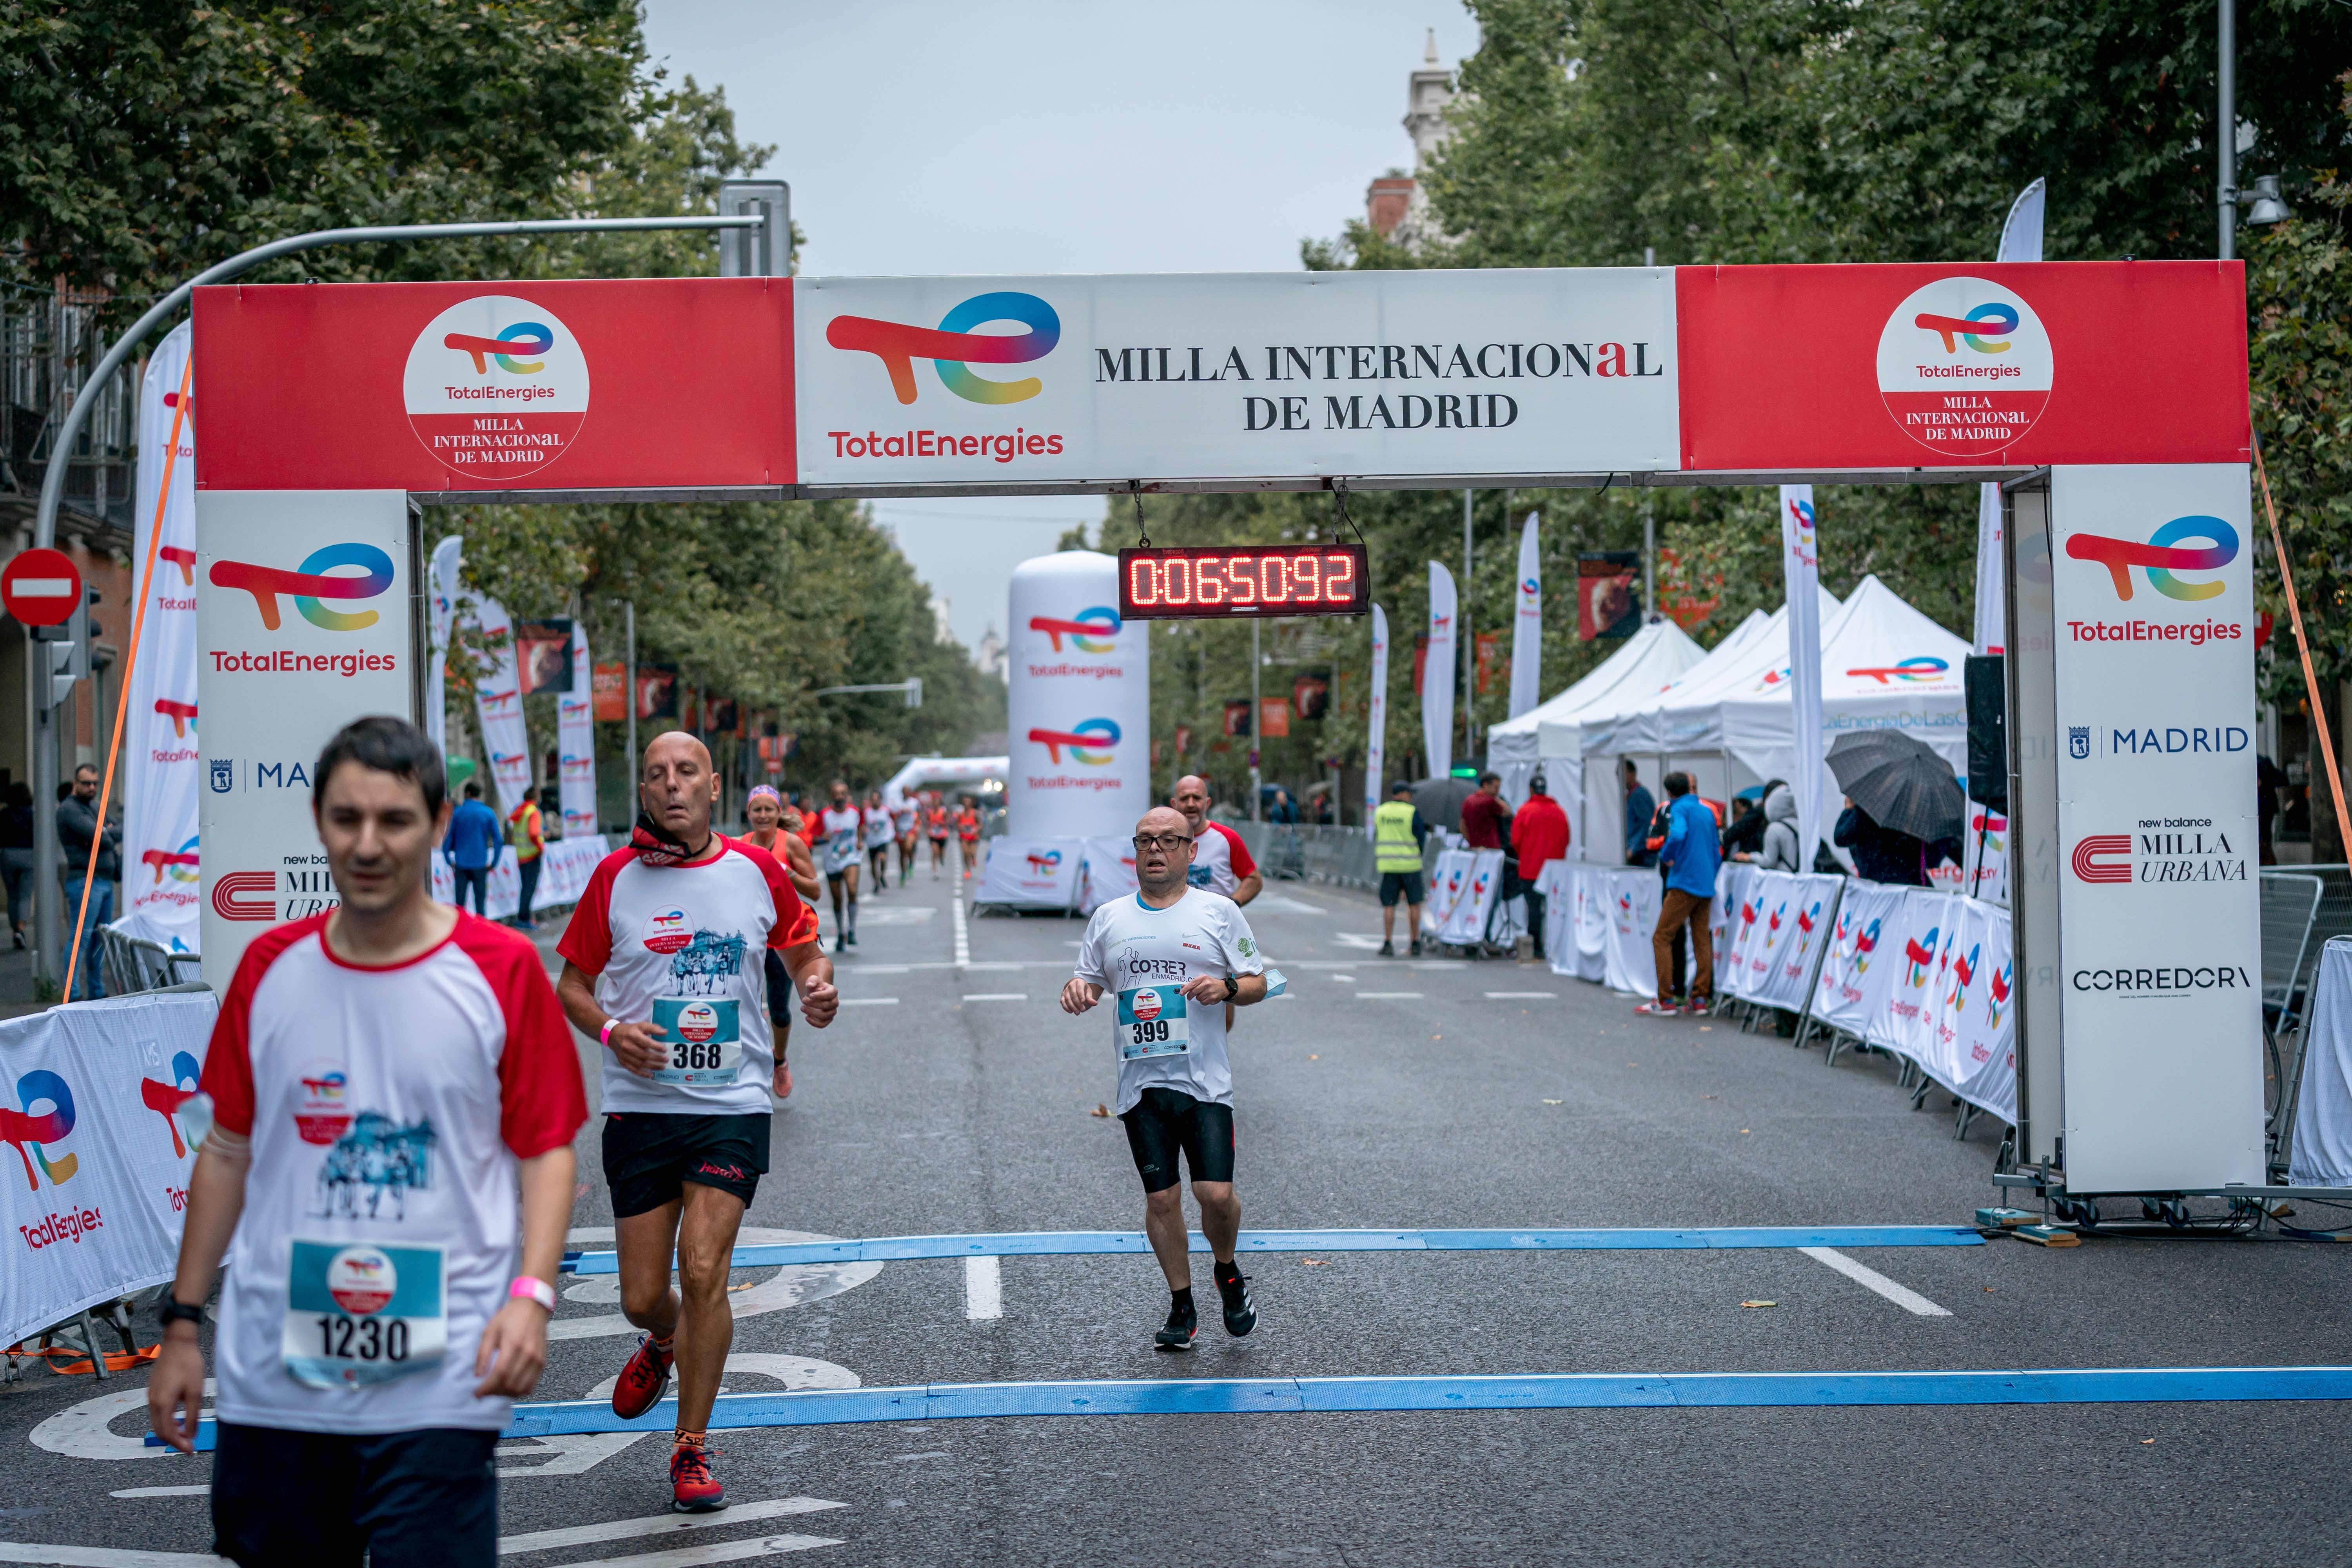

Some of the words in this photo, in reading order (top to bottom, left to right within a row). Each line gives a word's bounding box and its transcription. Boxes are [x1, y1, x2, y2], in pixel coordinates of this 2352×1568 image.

[1095, 345, 1254, 382] MILLA
[1916, 364, 2020, 380] TotalEnergies
[445, 385, 555, 401] TotalEnergies
[1943, 396, 1992, 408] MILLA
[1243, 396, 1310, 430] DE
[1324, 394, 1518, 429] MADRID
[474, 418, 524, 430] MILLA
[1926, 428, 1947, 440] DE
[1951, 428, 2011, 439] MADRID
[828, 427, 1063, 463] TotalEnergies
[454, 451, 476, 463] DE
[480, 450, 544, 463] MADRID
[2067, 618, 2241, 645] TotalEnergies
[210, 649, 395, 677] TotalEnergies
[1029, 663, 1123, 681] TotalEnergies
[2114, 727, 2248, 753] MADRID
[1028, 775, 1122, 792] TotalEnergies
[2139, 819, 2161, 828] new
[2164, 817, 2212, 828] balance
[2140, 833, 2234, 855] MILLA
[2141, 860, 2248, 882] URBANA
[1130, 959, 1186, 976] CORRER
[1132, 1020, 1169, 1044] 399
[673, 1043, 722, 1069] 368
[317, 1315, 410, 1363] 1230
